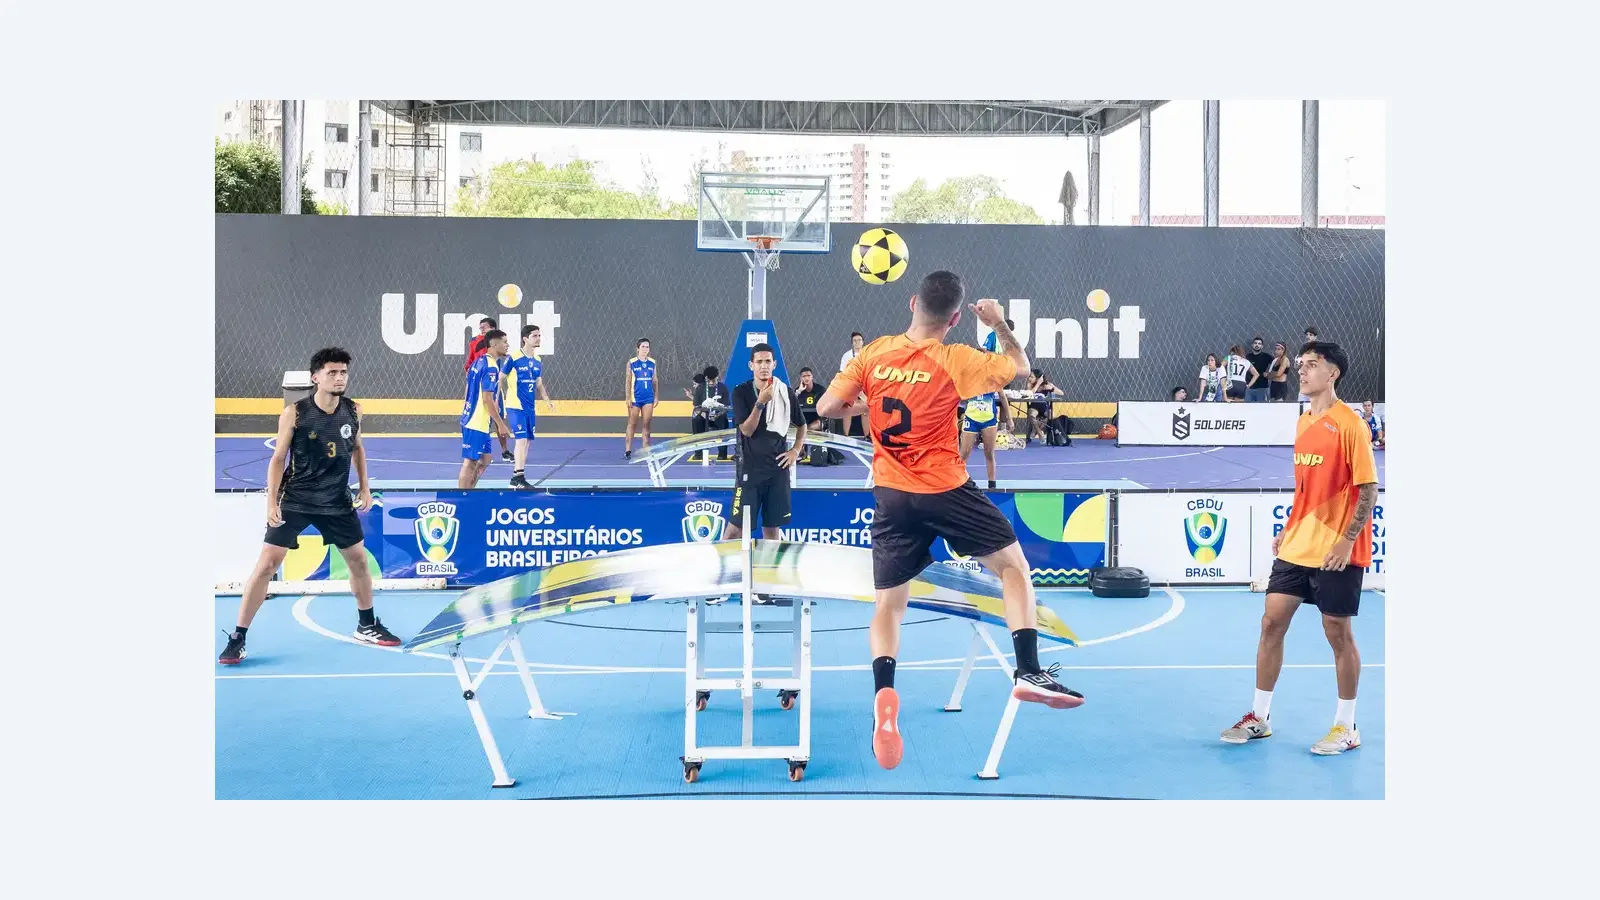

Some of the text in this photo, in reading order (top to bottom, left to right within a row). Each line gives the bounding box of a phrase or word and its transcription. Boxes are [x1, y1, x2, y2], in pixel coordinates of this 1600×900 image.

[381, 283, 561, 355] Unit
[1232, 363, 1246, 376] 17
[528, 383, 534, 393] 2
[643, 381, 648, 389] 1
[806, 396, 814, 405] 6
[881, 396, 912, 449] 2
[1193, 420, 1246, 430] SOLDIERS
[327, 441, 337, 458] 3
[420, 504, 454, 515] CBDU
[687, 502, 720, 514] CBDU
[1187, 498, 1224, 511] CBDU
[486, 507, 555, 525] JOGOS
[486, 525, 643, 546] UNIVERSITÁRIOS
[419, 564, 456, 573] BRASIL
[1185, 567, 1226, 578] BRASIL
